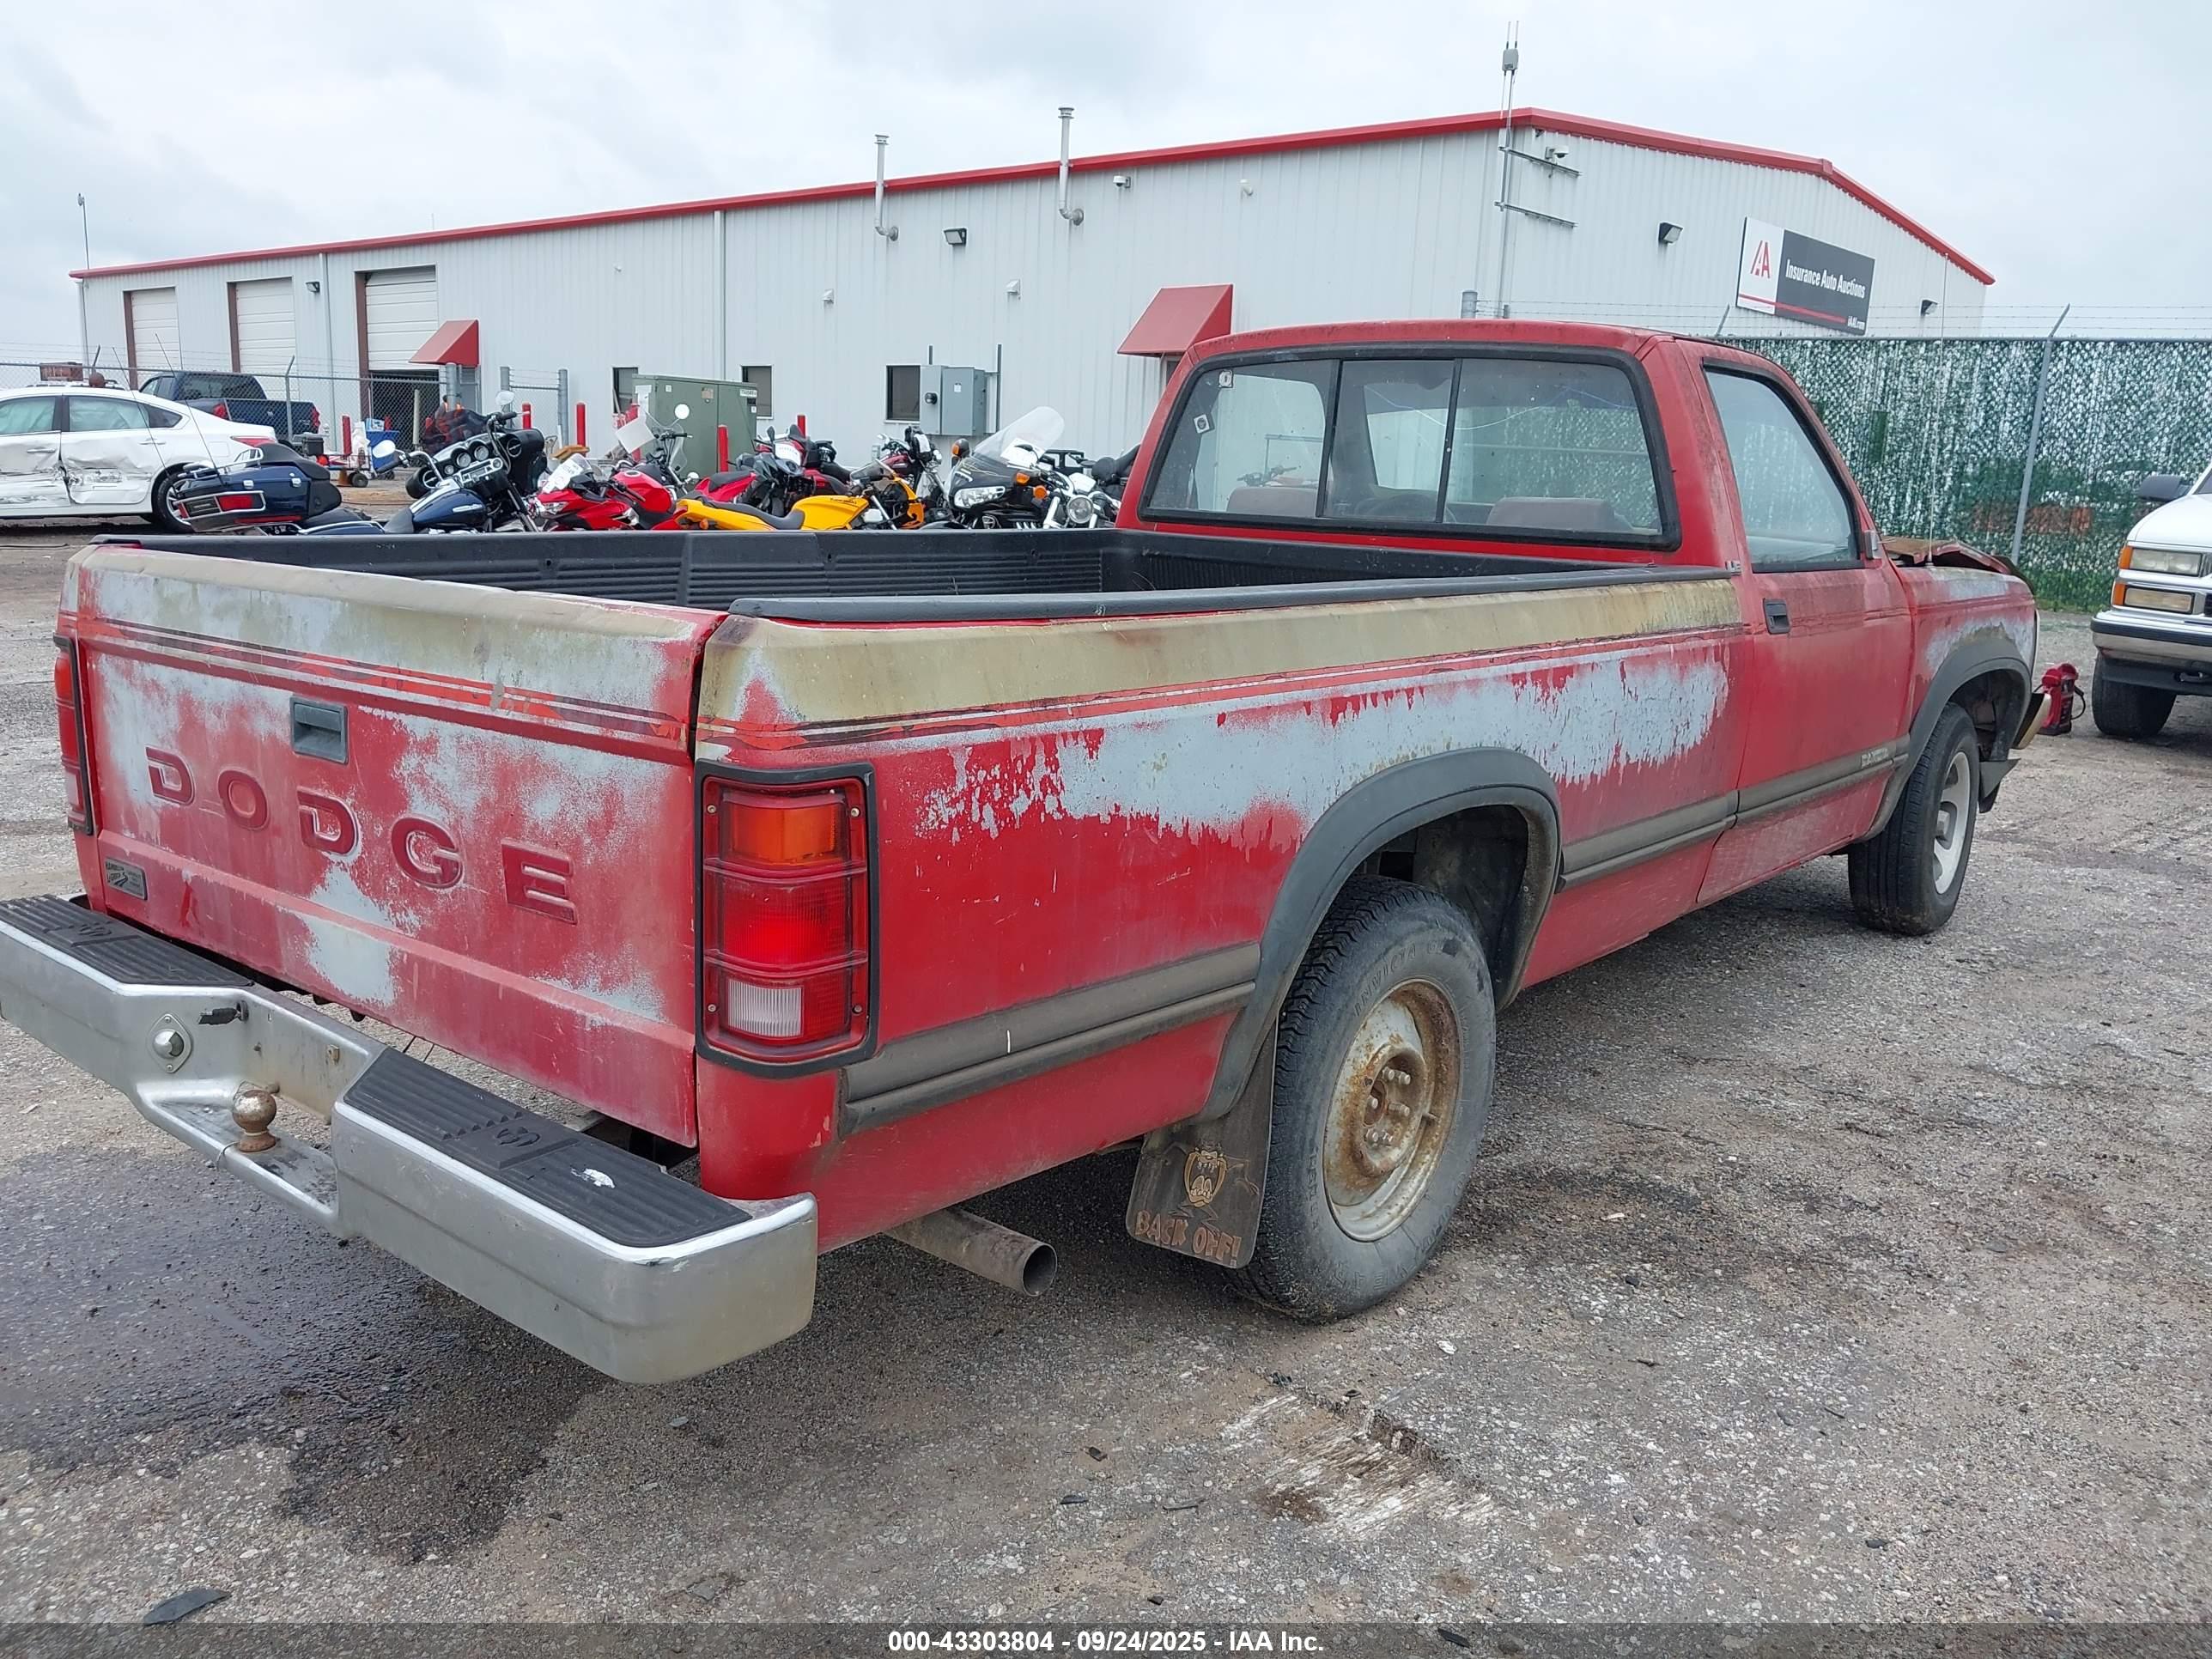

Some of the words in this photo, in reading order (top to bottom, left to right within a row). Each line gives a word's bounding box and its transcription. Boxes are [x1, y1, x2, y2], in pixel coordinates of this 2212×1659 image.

[1785, 258, 1821, 287] Insurance
[1820, 269, 1837, 292] Auto
[1836, 275, 1866, 299] Auctions
[144, 744, 577, 925] DODGE
[1135, 1209, 1189, 1246] BACK
[1192, 1227, 1243, 1267] OFF!
